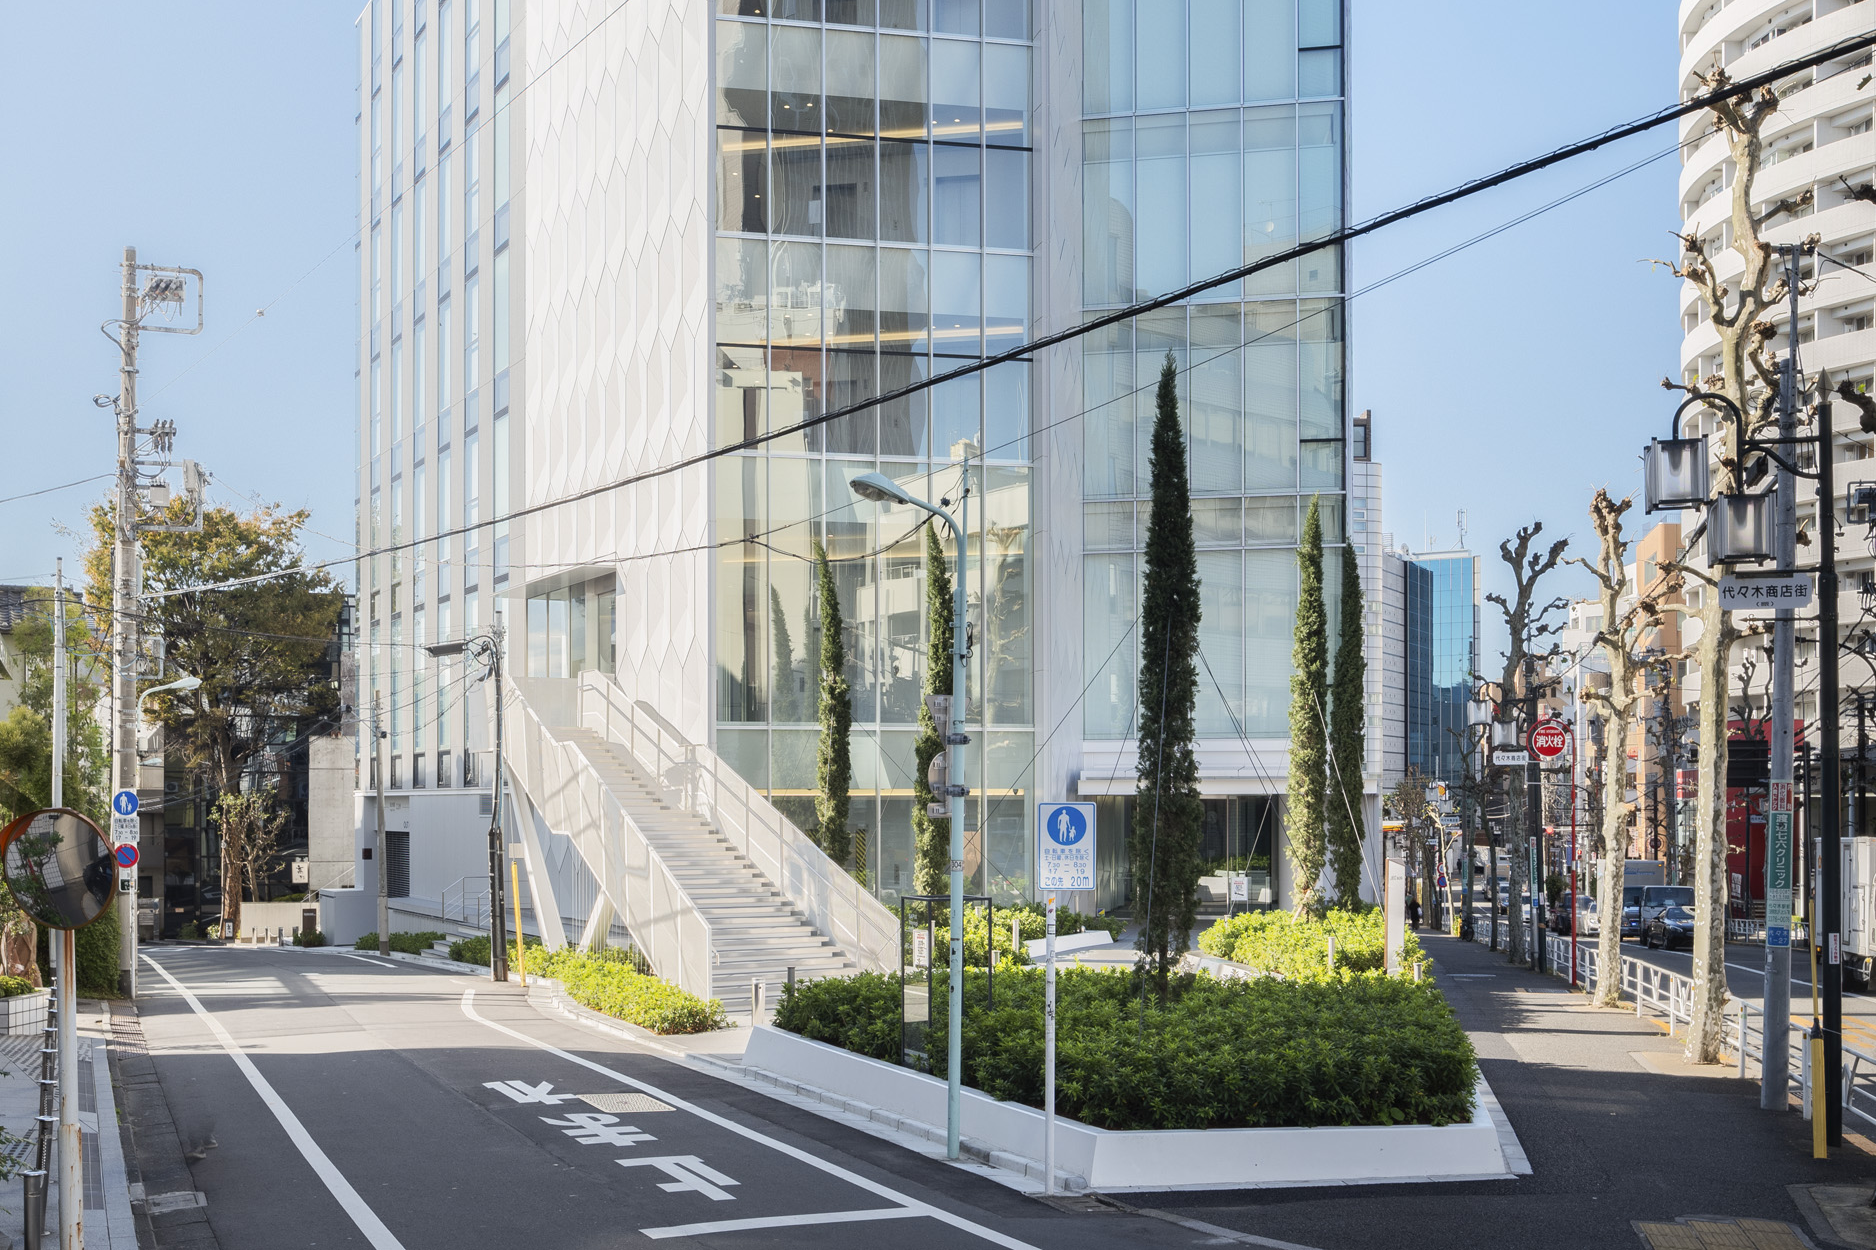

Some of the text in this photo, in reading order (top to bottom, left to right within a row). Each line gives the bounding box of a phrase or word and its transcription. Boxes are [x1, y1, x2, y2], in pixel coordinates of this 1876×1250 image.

[1722, 584, 1808, 599] 代々木商店街
[1536, 735, 1563, 747] 消火栓
[1775, 814, 1788, 888] 渡辺七六クリニック
[1045, 876, 1090, 887] この先 20m
[482, 1080, 741, 1201] 止まれ
